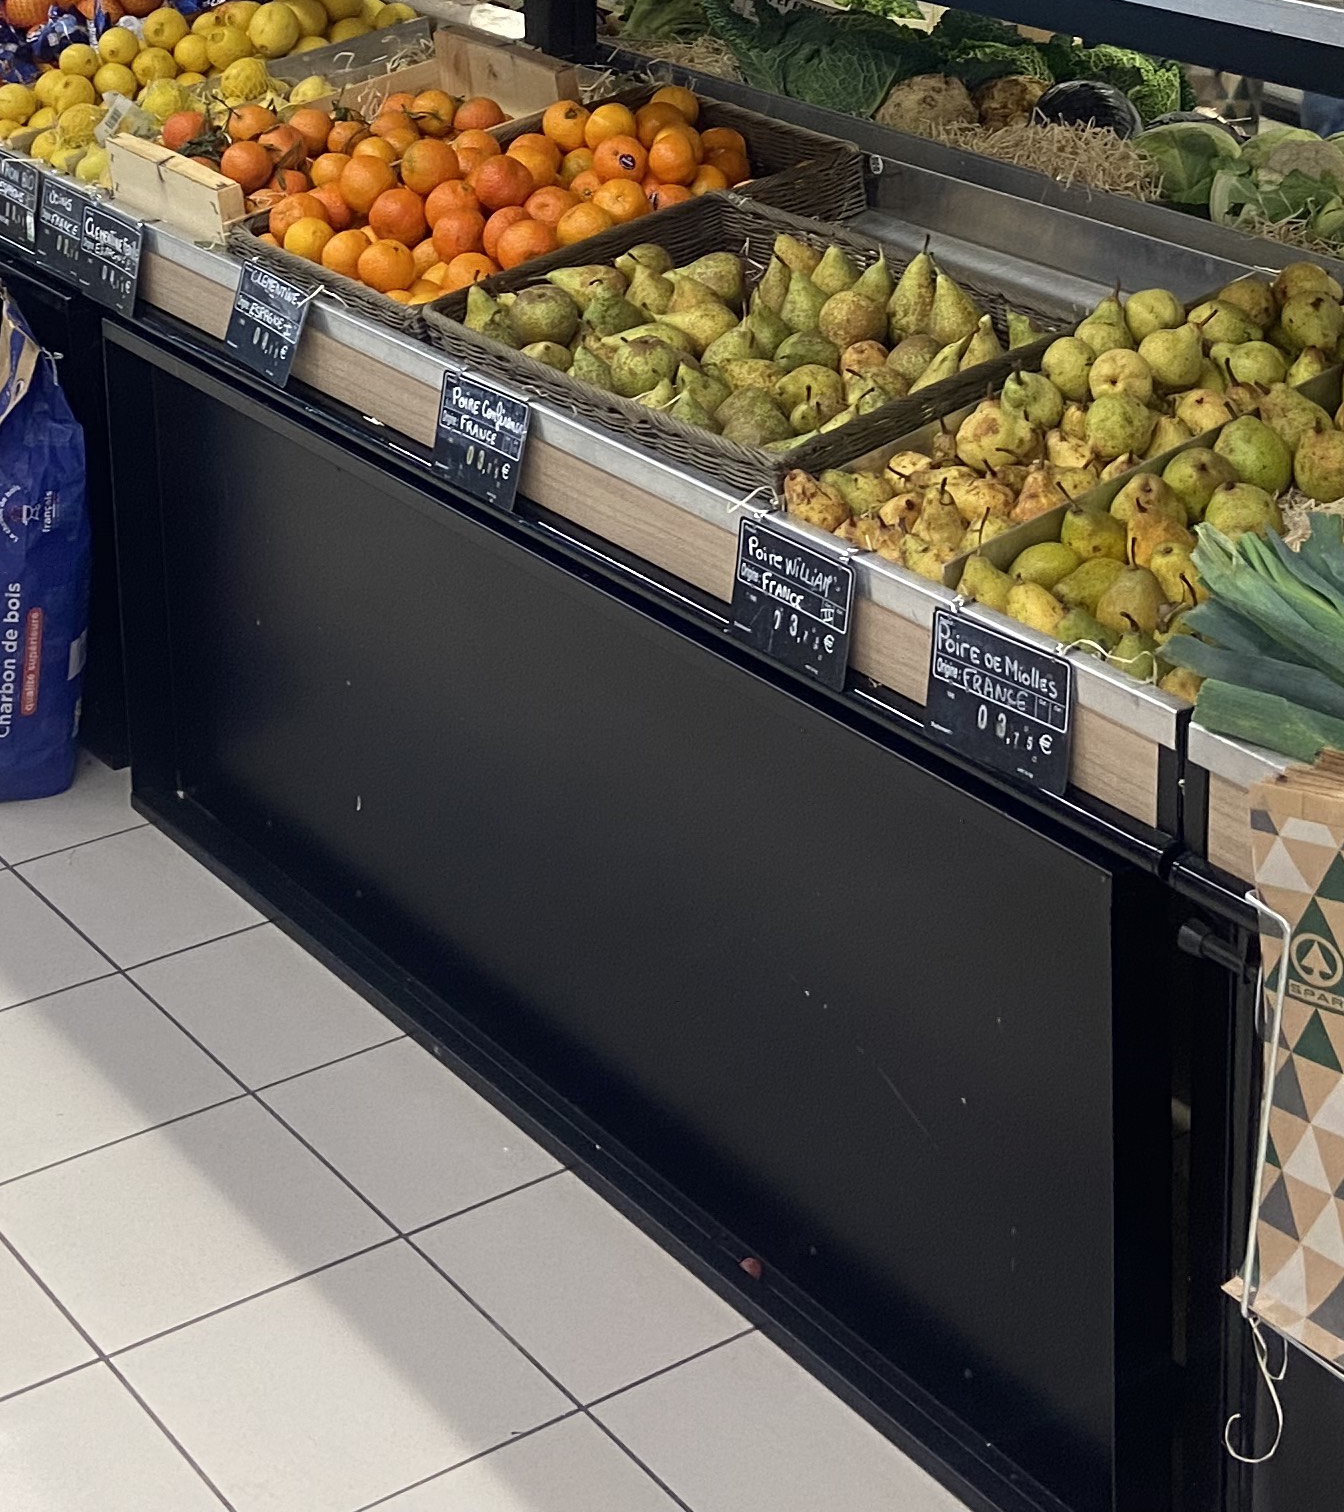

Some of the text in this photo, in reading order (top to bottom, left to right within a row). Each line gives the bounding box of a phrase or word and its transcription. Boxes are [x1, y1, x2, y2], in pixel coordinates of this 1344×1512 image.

[460, 414, 498, 446] FRANCE
[3, 582, 21, 624] bois
[1, 629, 18, 653] de
[962, 668, 1029, 711] FRANCE
[1291, 983, 1344, 1009] SPAR
